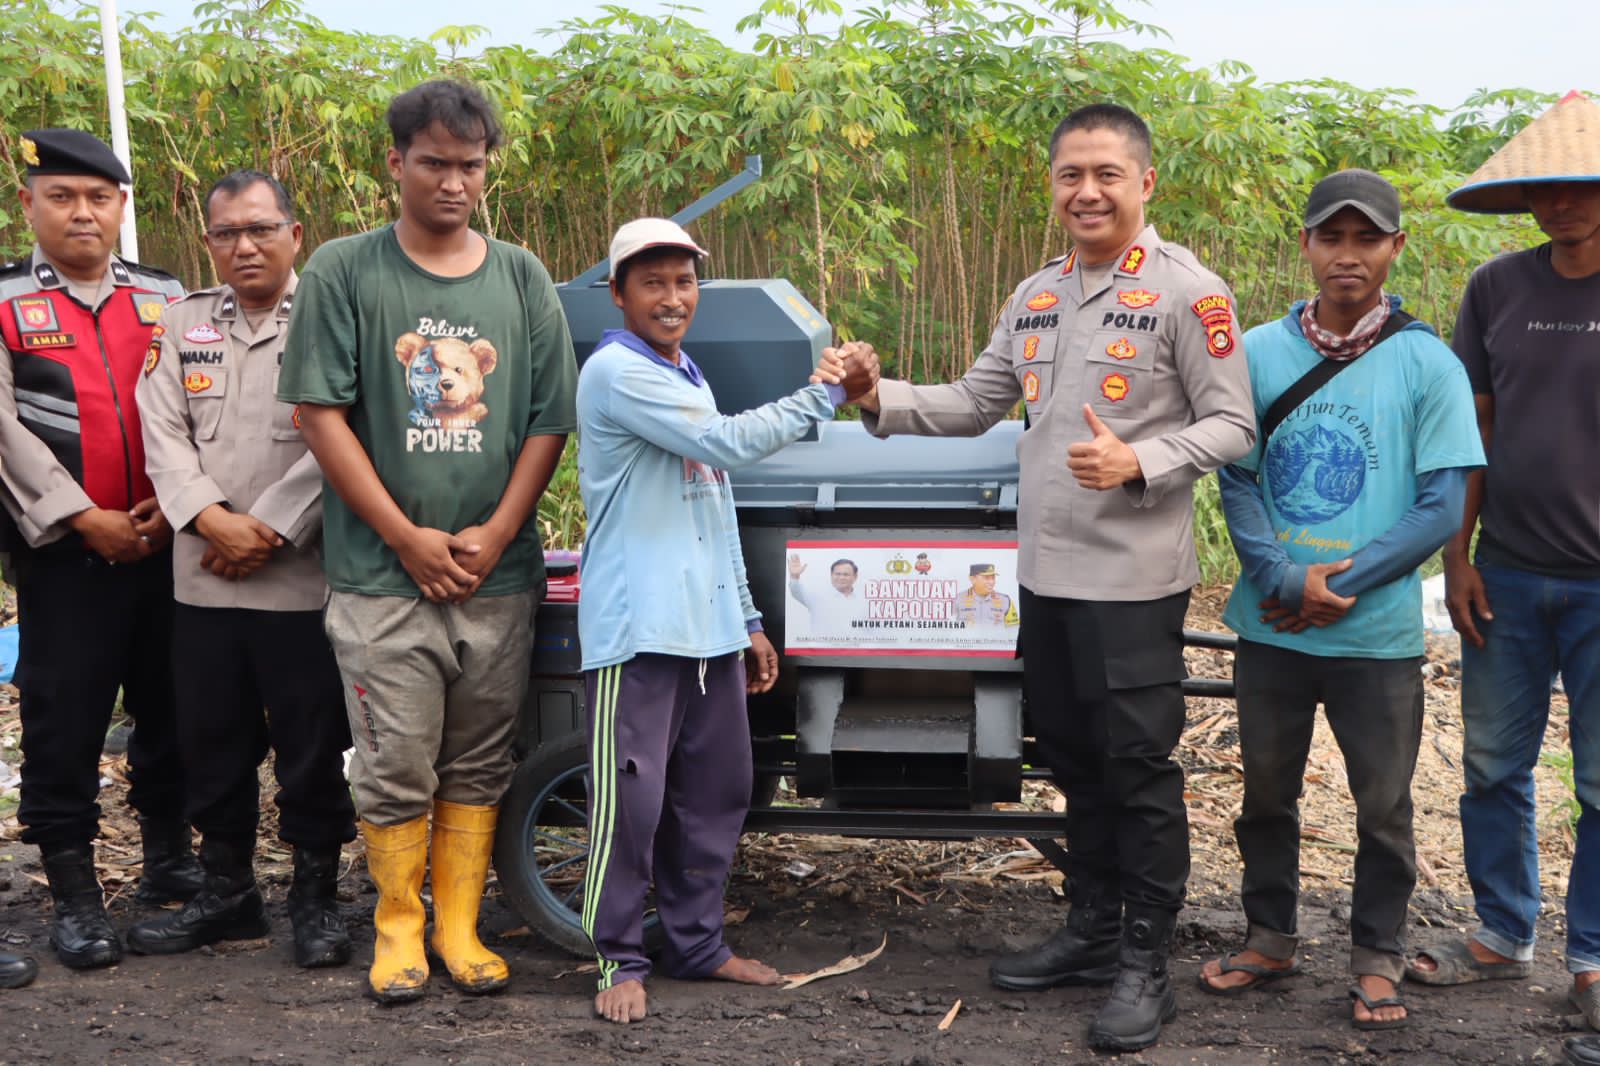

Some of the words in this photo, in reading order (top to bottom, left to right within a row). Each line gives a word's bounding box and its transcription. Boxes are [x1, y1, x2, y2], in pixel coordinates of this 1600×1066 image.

[416, 317, 478, 337] Believe
[1014, 313, 1059, 331] BAGUS
[1102, 312, 1157, 332] POLRI
[32, 335, 68, 345] AMAR
[417, 416, 441, 427] YOUR
[406, 428, 483, 452] POWER
[865, 579, 958, 599] BANTUAN
[869, 600, 954, 619] KAPOLRI
[851, 620, 880, 629] UNTUK
[884, 620, 914, 629] PETANI
